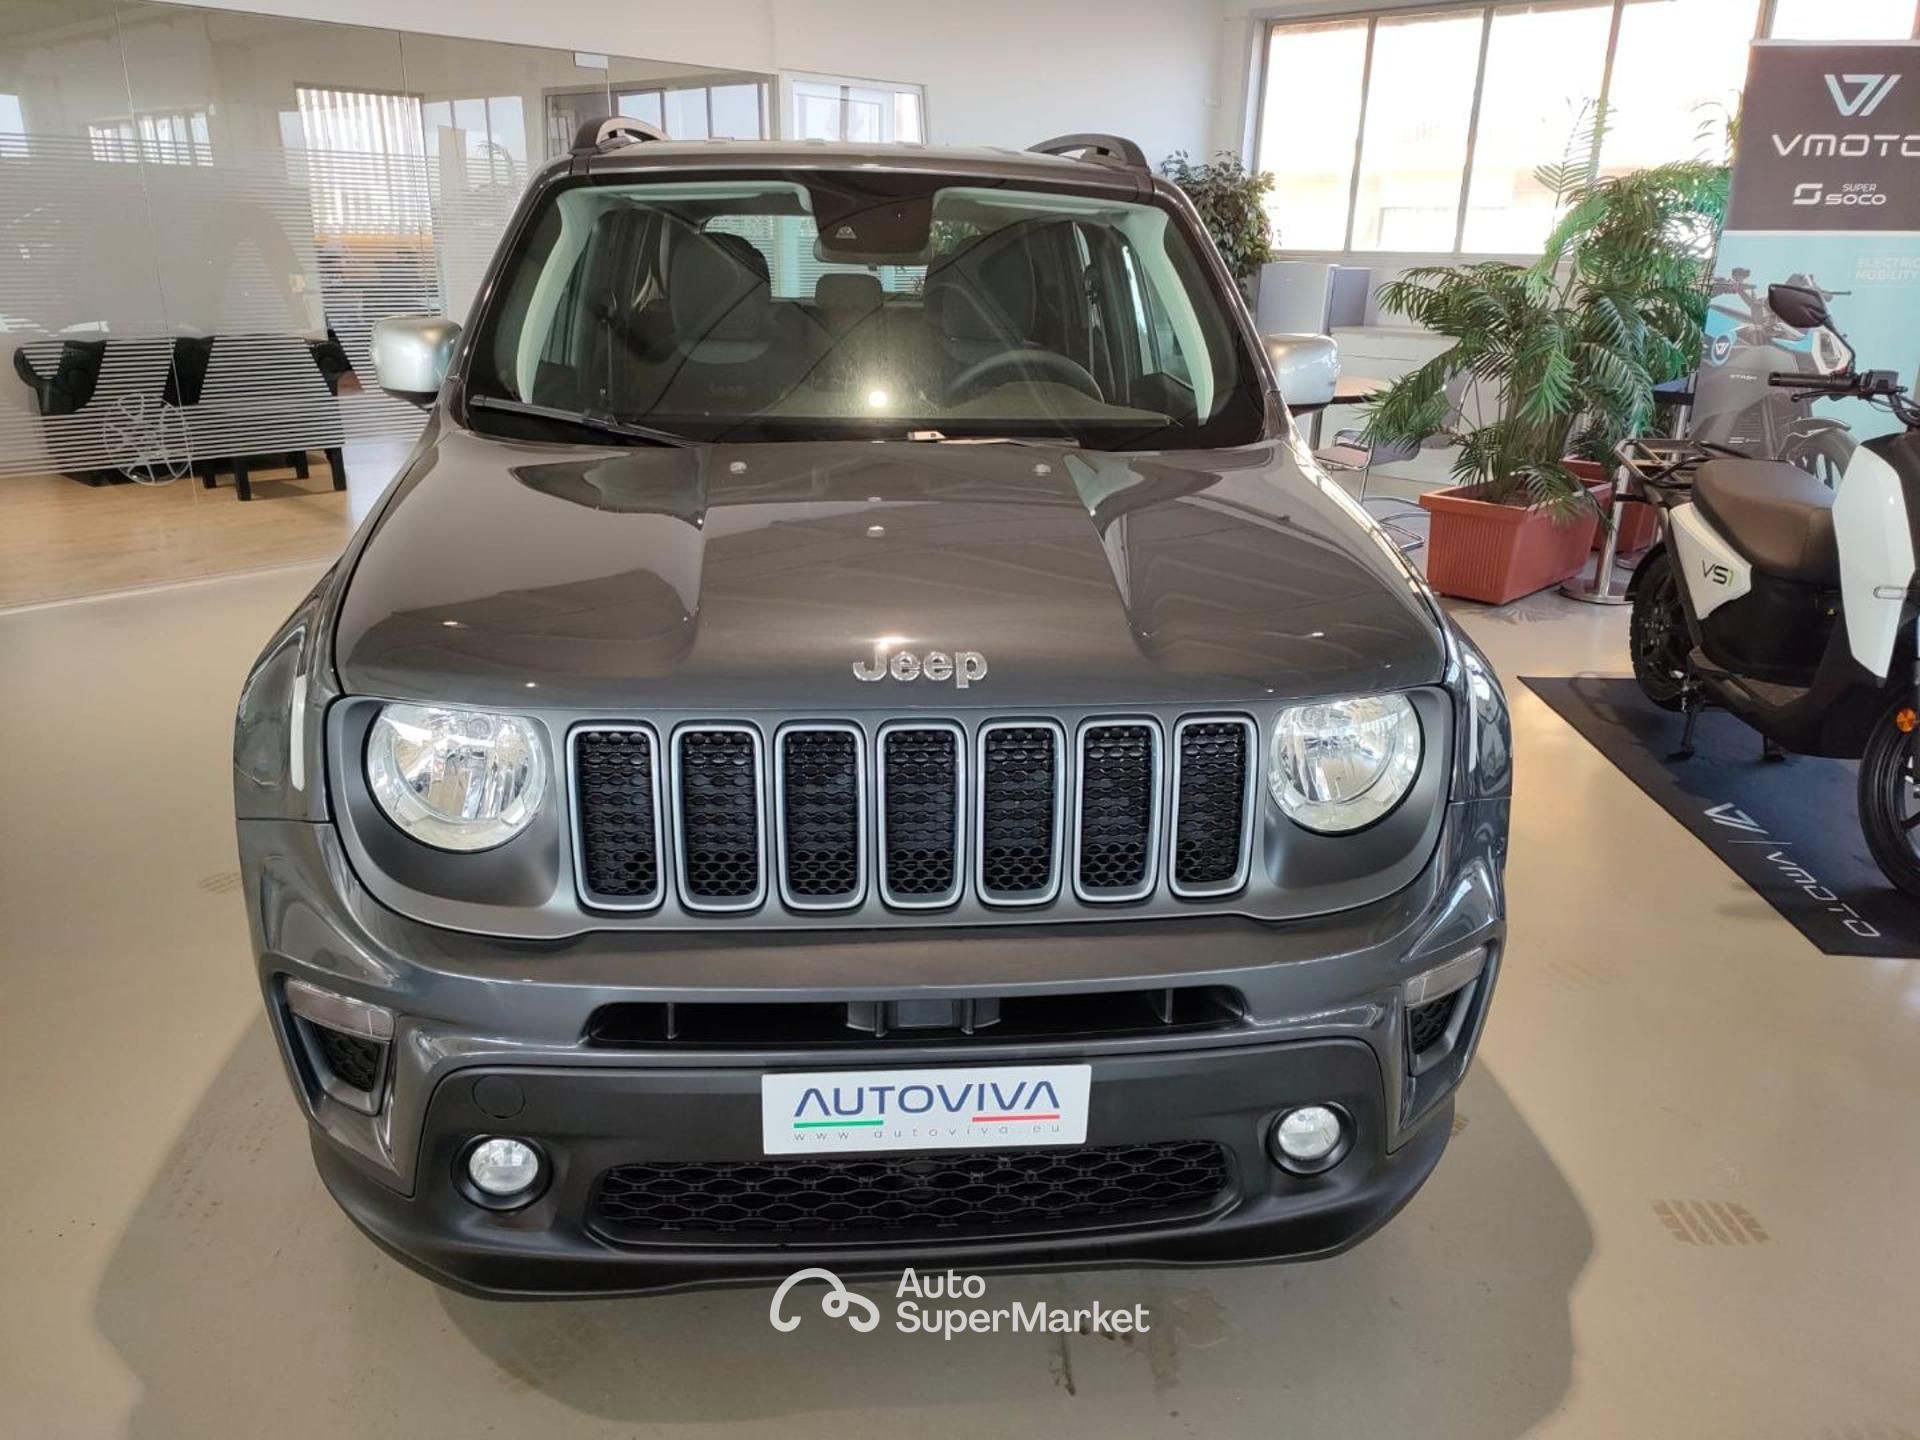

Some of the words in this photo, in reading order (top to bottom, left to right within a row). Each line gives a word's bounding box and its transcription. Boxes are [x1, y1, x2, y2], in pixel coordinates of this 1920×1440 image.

[1772, 134, 1920, 157] VMOTO
[1825, 194, 1887, 205] SOCO
[1842, 183, 1877, 192] SUPER
[852, 640, 988, 688] Jeep
[1766, 851, 1881, 937] VMOTO
[794, 1081, 1060, 1117] AUTOVIVA
